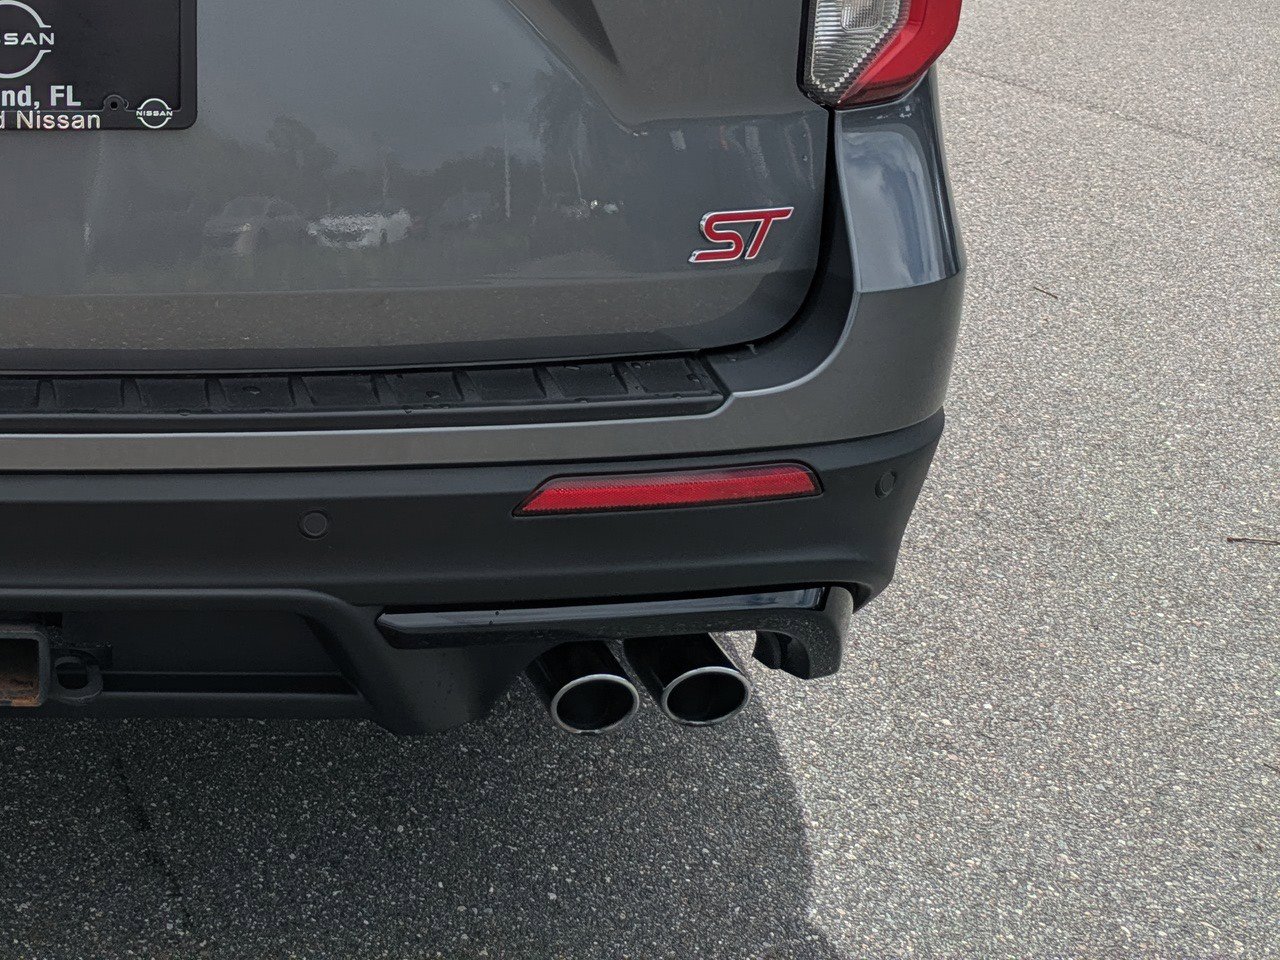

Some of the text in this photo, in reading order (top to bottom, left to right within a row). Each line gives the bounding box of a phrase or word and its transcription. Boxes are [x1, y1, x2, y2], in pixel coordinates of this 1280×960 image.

[50, 85, 82, 107] FL
[16, 111, 101, 130] Nissan
[135, 109, 173, 117] NISSAN
[688, 206, 794, 263] ST
